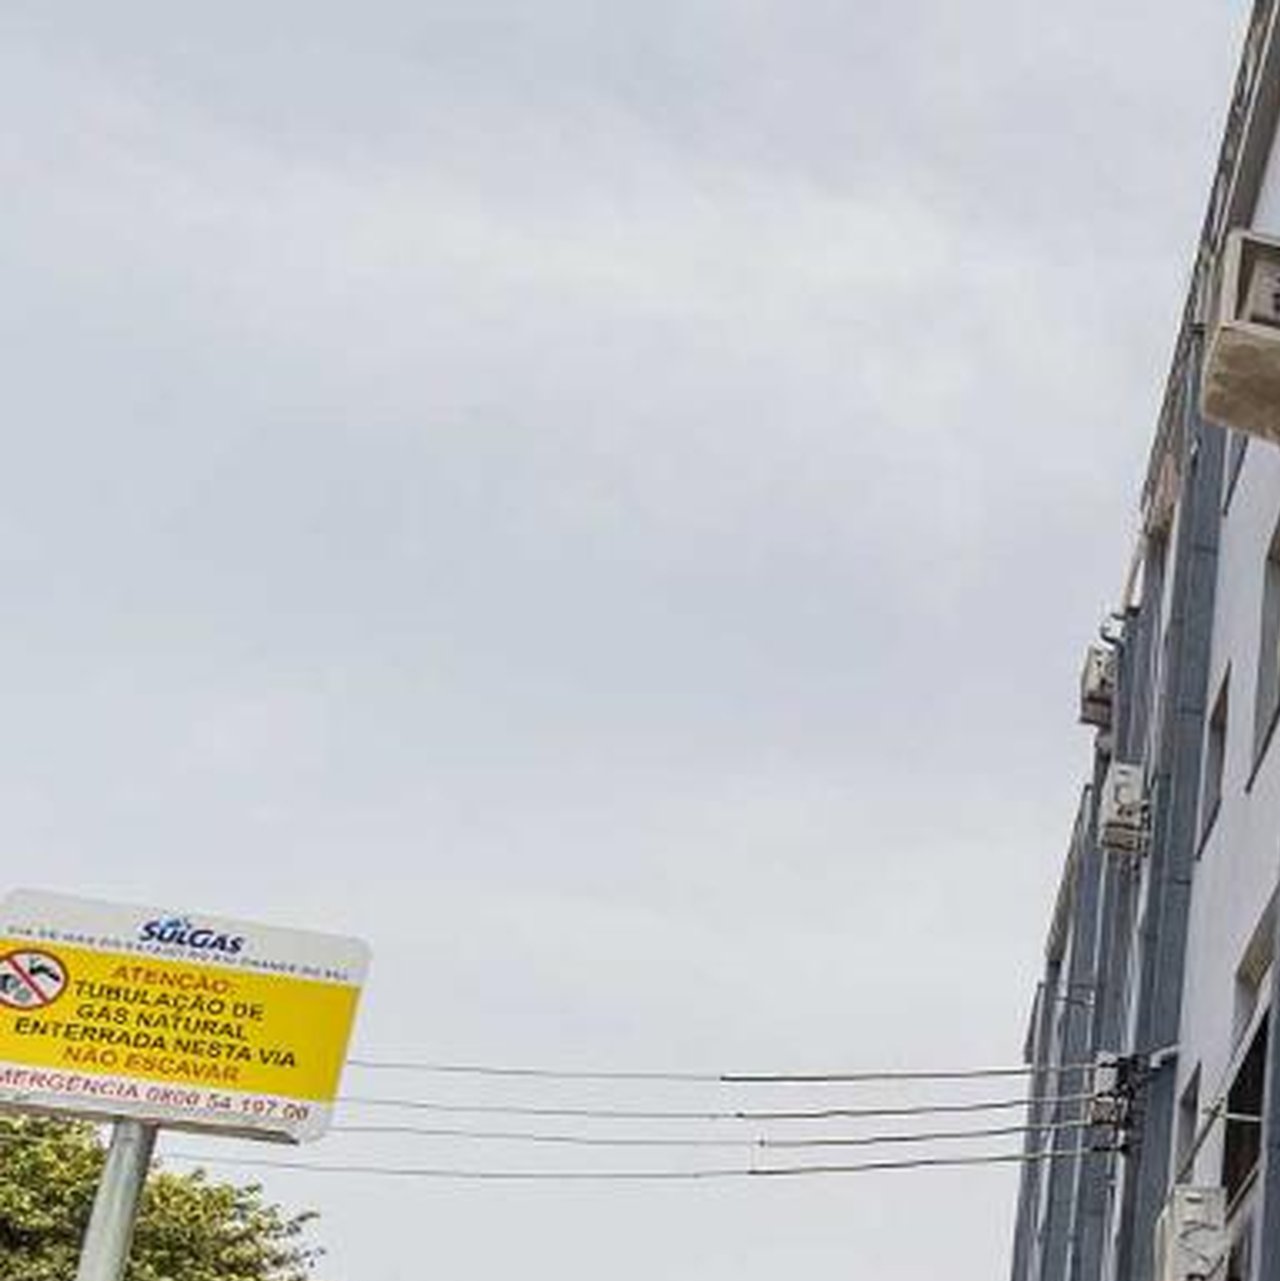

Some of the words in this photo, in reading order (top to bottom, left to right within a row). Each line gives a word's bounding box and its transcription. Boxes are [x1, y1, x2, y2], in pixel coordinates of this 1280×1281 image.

[233, 1002, 265, 1021] DE
[136, 1013, 247, 1040] NATURAL
[15, 1018, 167, 1050] ENTERRADA
[174, 1038, 251, 1062] NESTA
[258, 1046, 297, 1068] VIA
[123, 1053, 240, 1082] ESCAVAR
